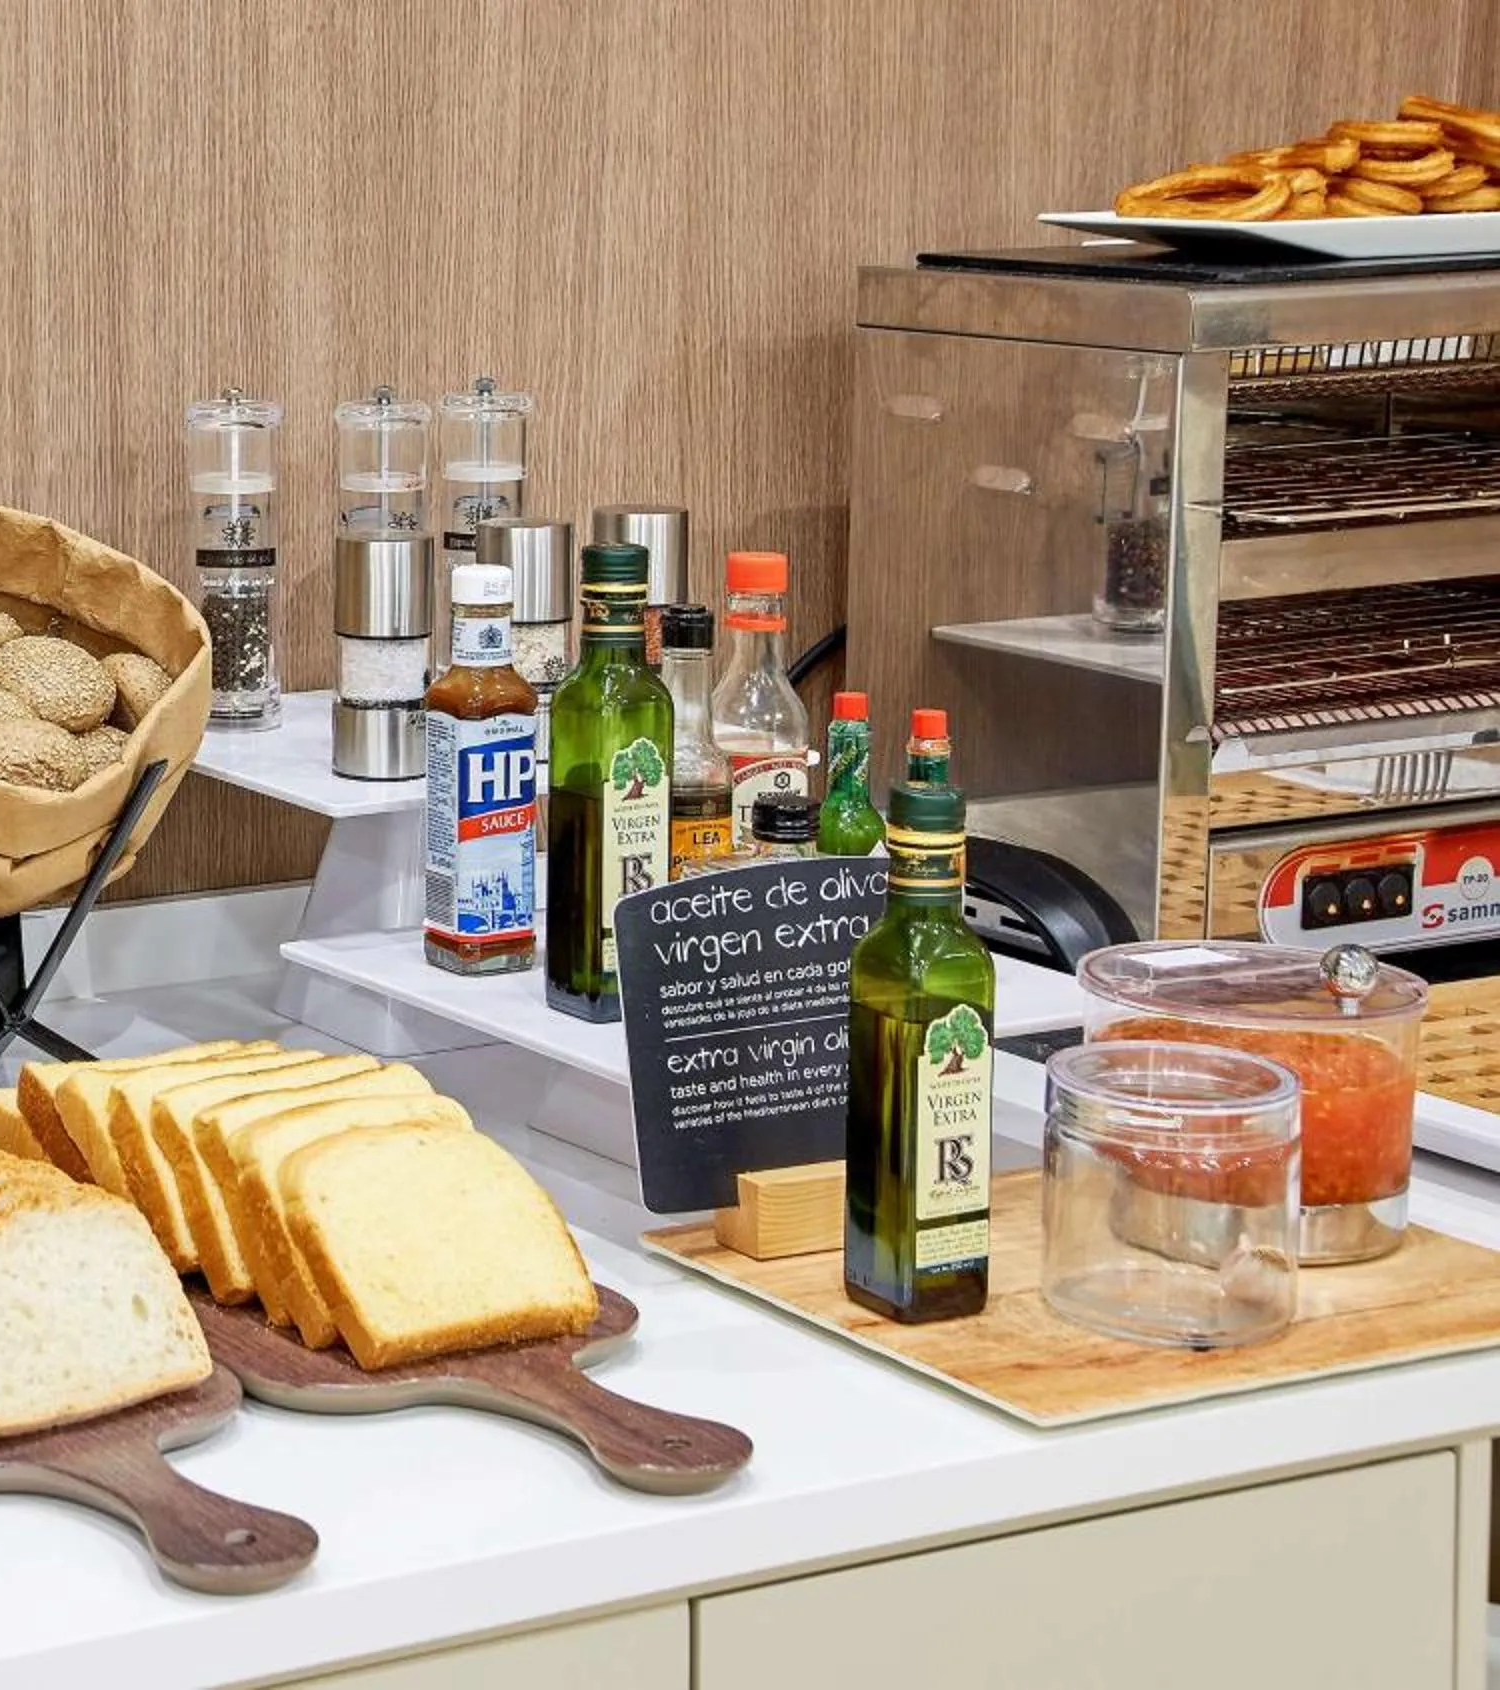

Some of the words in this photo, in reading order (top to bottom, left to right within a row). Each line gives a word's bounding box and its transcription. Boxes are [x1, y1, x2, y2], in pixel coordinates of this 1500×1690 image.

[467, 749, 536, 803] HP
[481, 810, 525, 833] SAUCE
[611, 815, 660, 831] VIRGEN
[617, 830, 656, 845] EXTRA
[693, 831, 721, 845] LEA
[650, 884, 753, 925] aceite
[765, 876, 808, 909] de
[653, 930, 762, 973] virgen
[775, 913, 869, 949] extra
[659, 980, 703, 999] sabor
[706, 980, 717, 995] y
[719, 969, 761, 991] salud
[763, 969, 783, 984] en
[787, 961, 824, 981] cada
[667, 1047, 739, 1073] extra
[748, 1031, 815, 1067] virgin
[670, 1081, 707, 1099] taste
[709, 1075, 737, 1093] and
[739, 1069, 785, 1089] health
[786, 1067, 801, 1081] in
[803, 1063, 843, 1079] every
[671, 1103, 713, 1117] discover
[713, 1099, 735, 1109] how
[767, 1092, 779, 1102] to
[927, 1090, 982, 1109] VIRGEN
[714, 1111, 725, 1123] of
[726, 1110, 743, 1121] the
[933, 1108, 977, 1126] EXTRA
